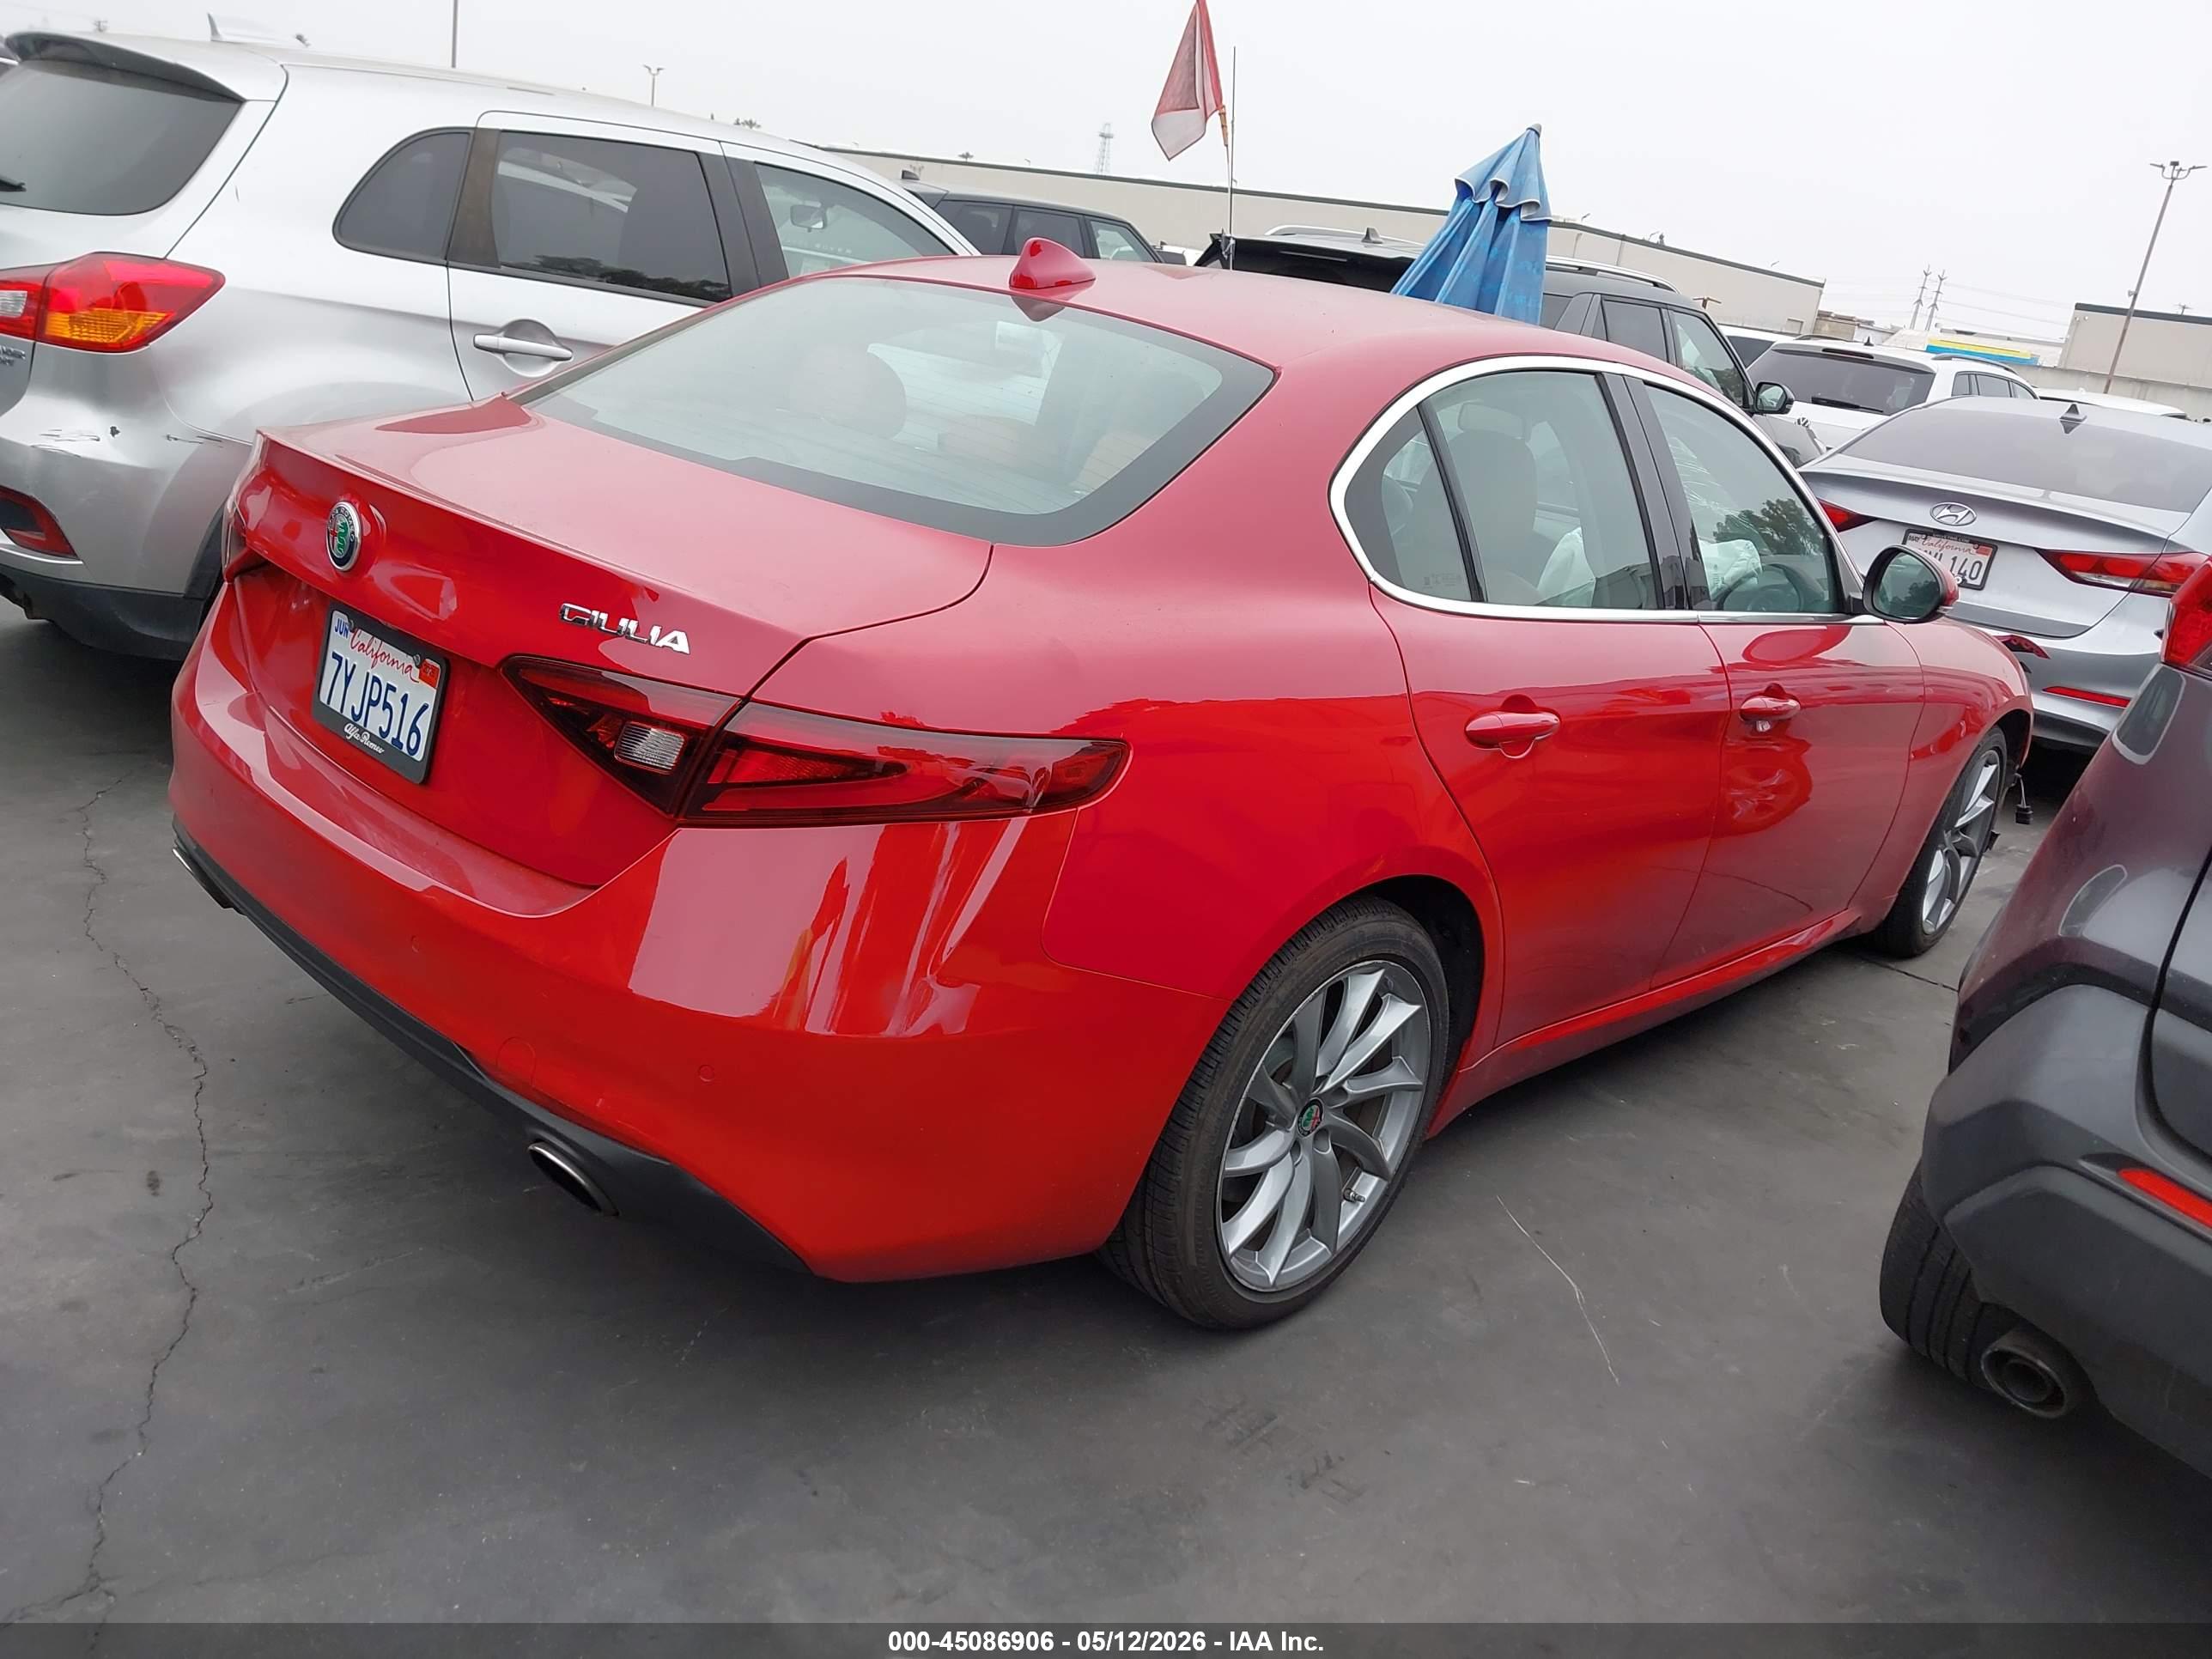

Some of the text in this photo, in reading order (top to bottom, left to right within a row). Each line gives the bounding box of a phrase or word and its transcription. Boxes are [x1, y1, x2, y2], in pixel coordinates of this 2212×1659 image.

[1923, 536, 1978, 556] California
[335, 617, 349, 639] JUN
[559, 602, 690, 654] GIULIA
[350, 628, 420, 684] California
[325, 650, 429, 757] 7YJP516
[343, 722, 386, 754] Alfa Romeo
